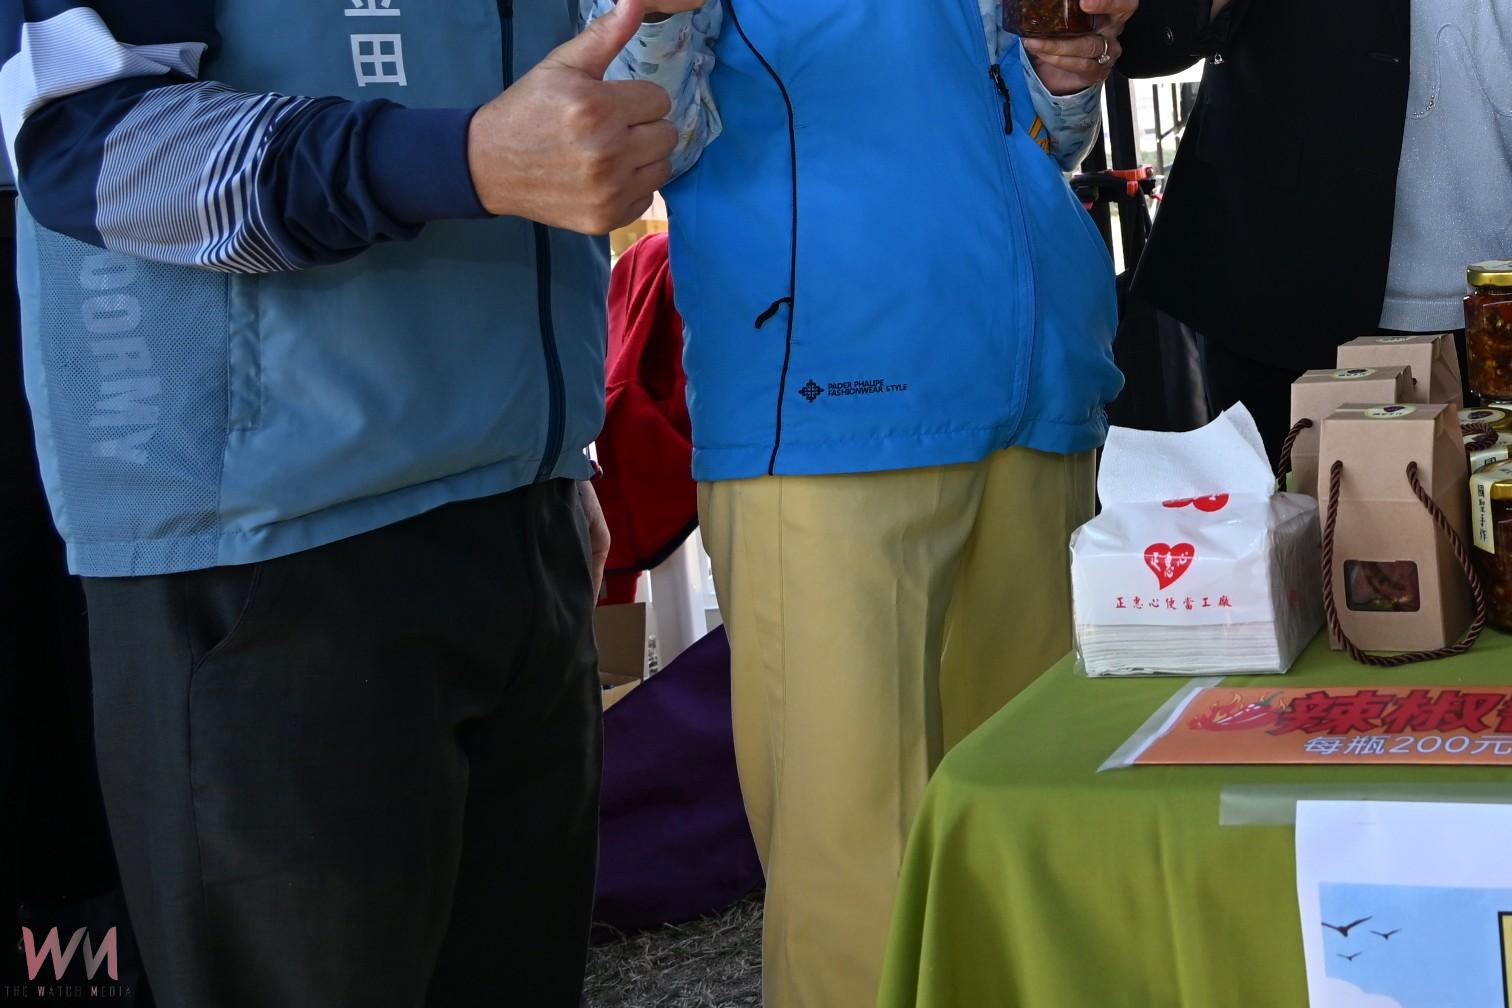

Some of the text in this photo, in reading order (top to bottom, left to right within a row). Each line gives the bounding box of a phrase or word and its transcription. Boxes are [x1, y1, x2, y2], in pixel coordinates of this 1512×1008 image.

[886, 384, 909, 392] STYLE
[1477, 484, 1488, 541] 國聖手作
[1116, 594, 1233, 610] 正惠心便當工廠
